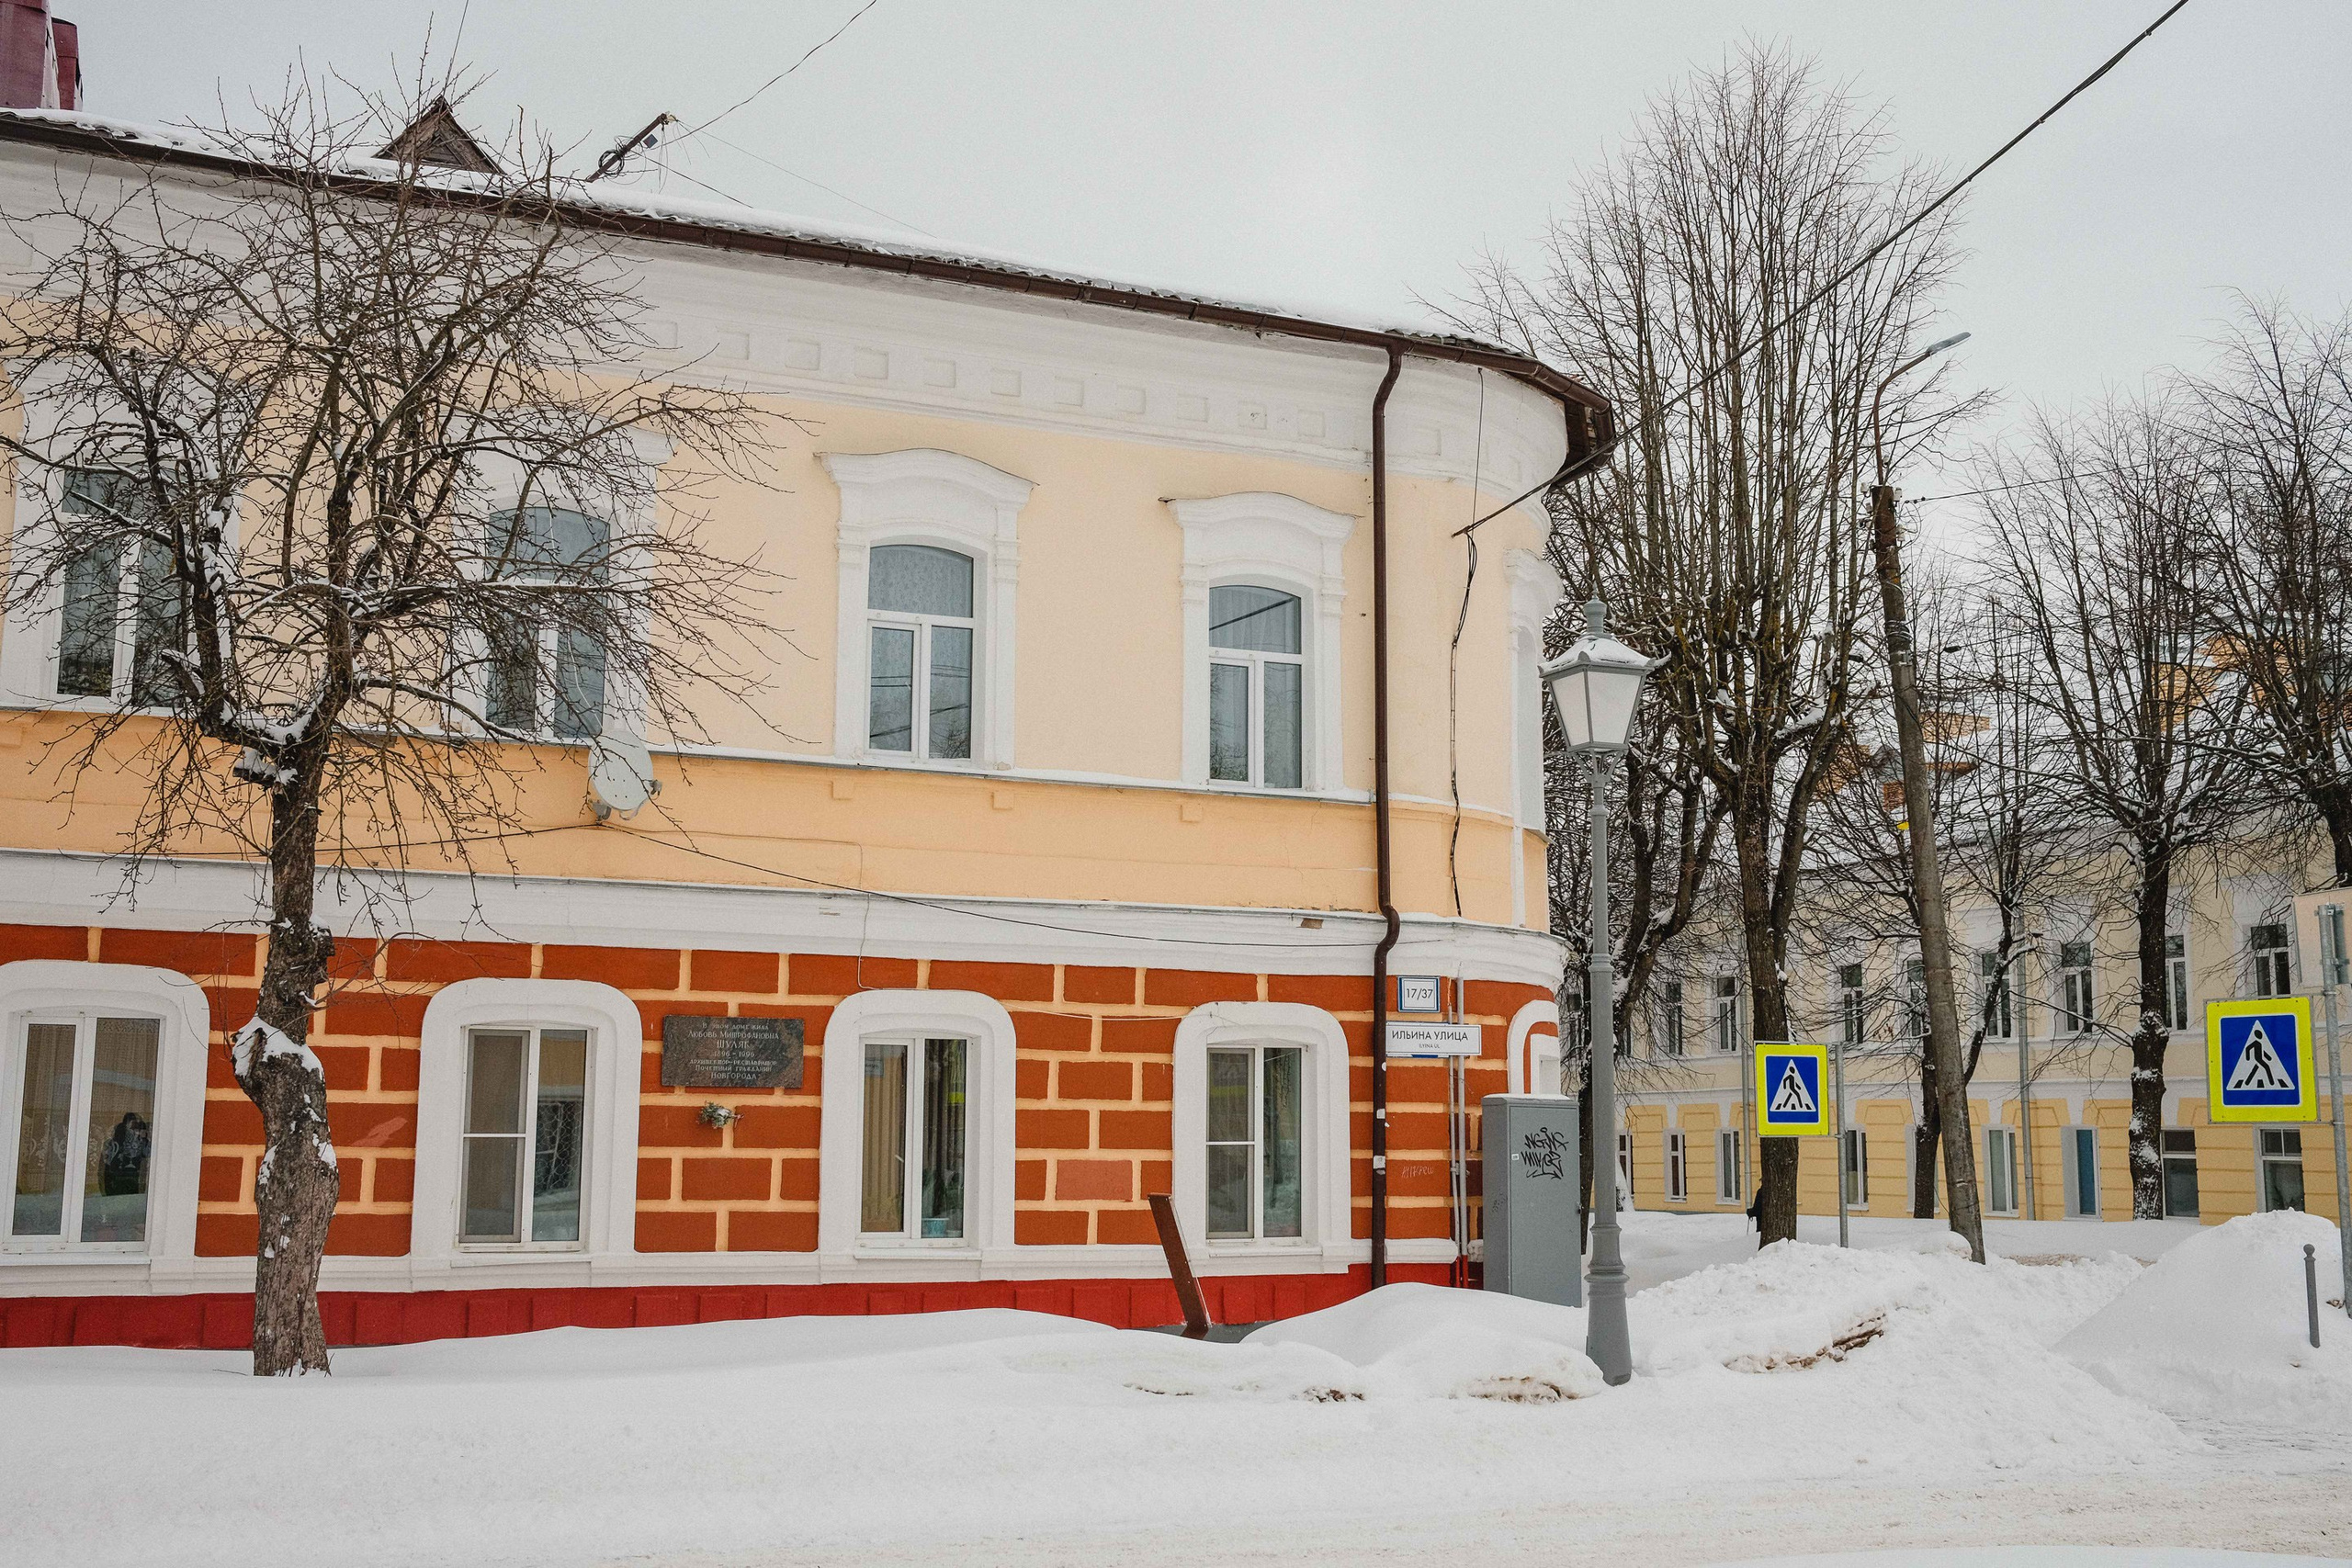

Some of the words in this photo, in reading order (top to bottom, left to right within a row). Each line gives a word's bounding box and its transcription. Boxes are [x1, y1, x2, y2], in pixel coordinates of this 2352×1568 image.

[1406, 988, 1433, 1000] 17/37
[1392, 1030, 1432, 1041] ИЛЬИНА
[1433, 1032, 1469, 1042] УЛИЦА
